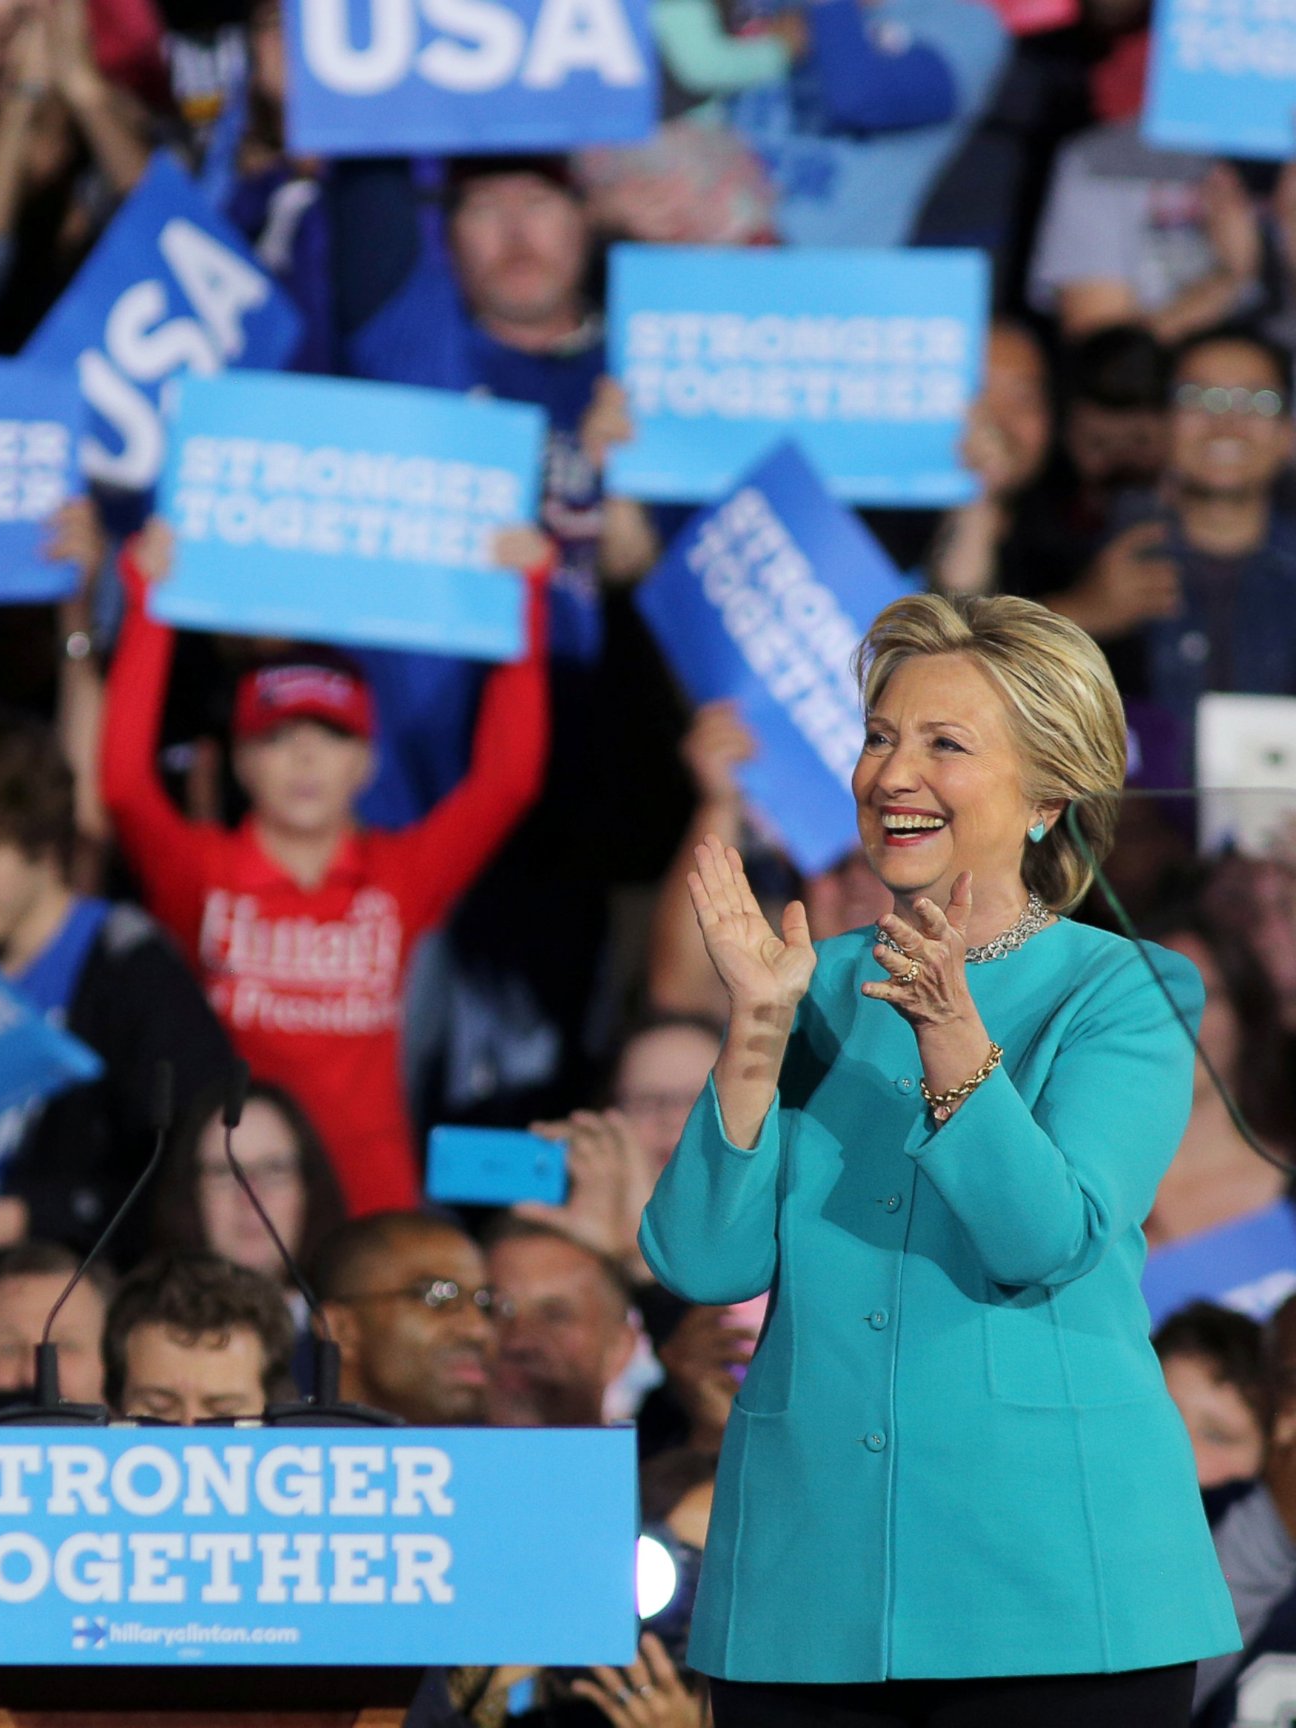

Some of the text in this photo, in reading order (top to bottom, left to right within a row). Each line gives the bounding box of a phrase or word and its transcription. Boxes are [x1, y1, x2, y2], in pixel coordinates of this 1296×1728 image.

[300, 0, 647, 97] USA
[626, 310, 966, 366] STRONGER
[622, 361, 968, 425] TOGETHER
[179, 433, 522, 520] STRONGER
[109, 1621, 301, 1647] hillaryclinton.com
